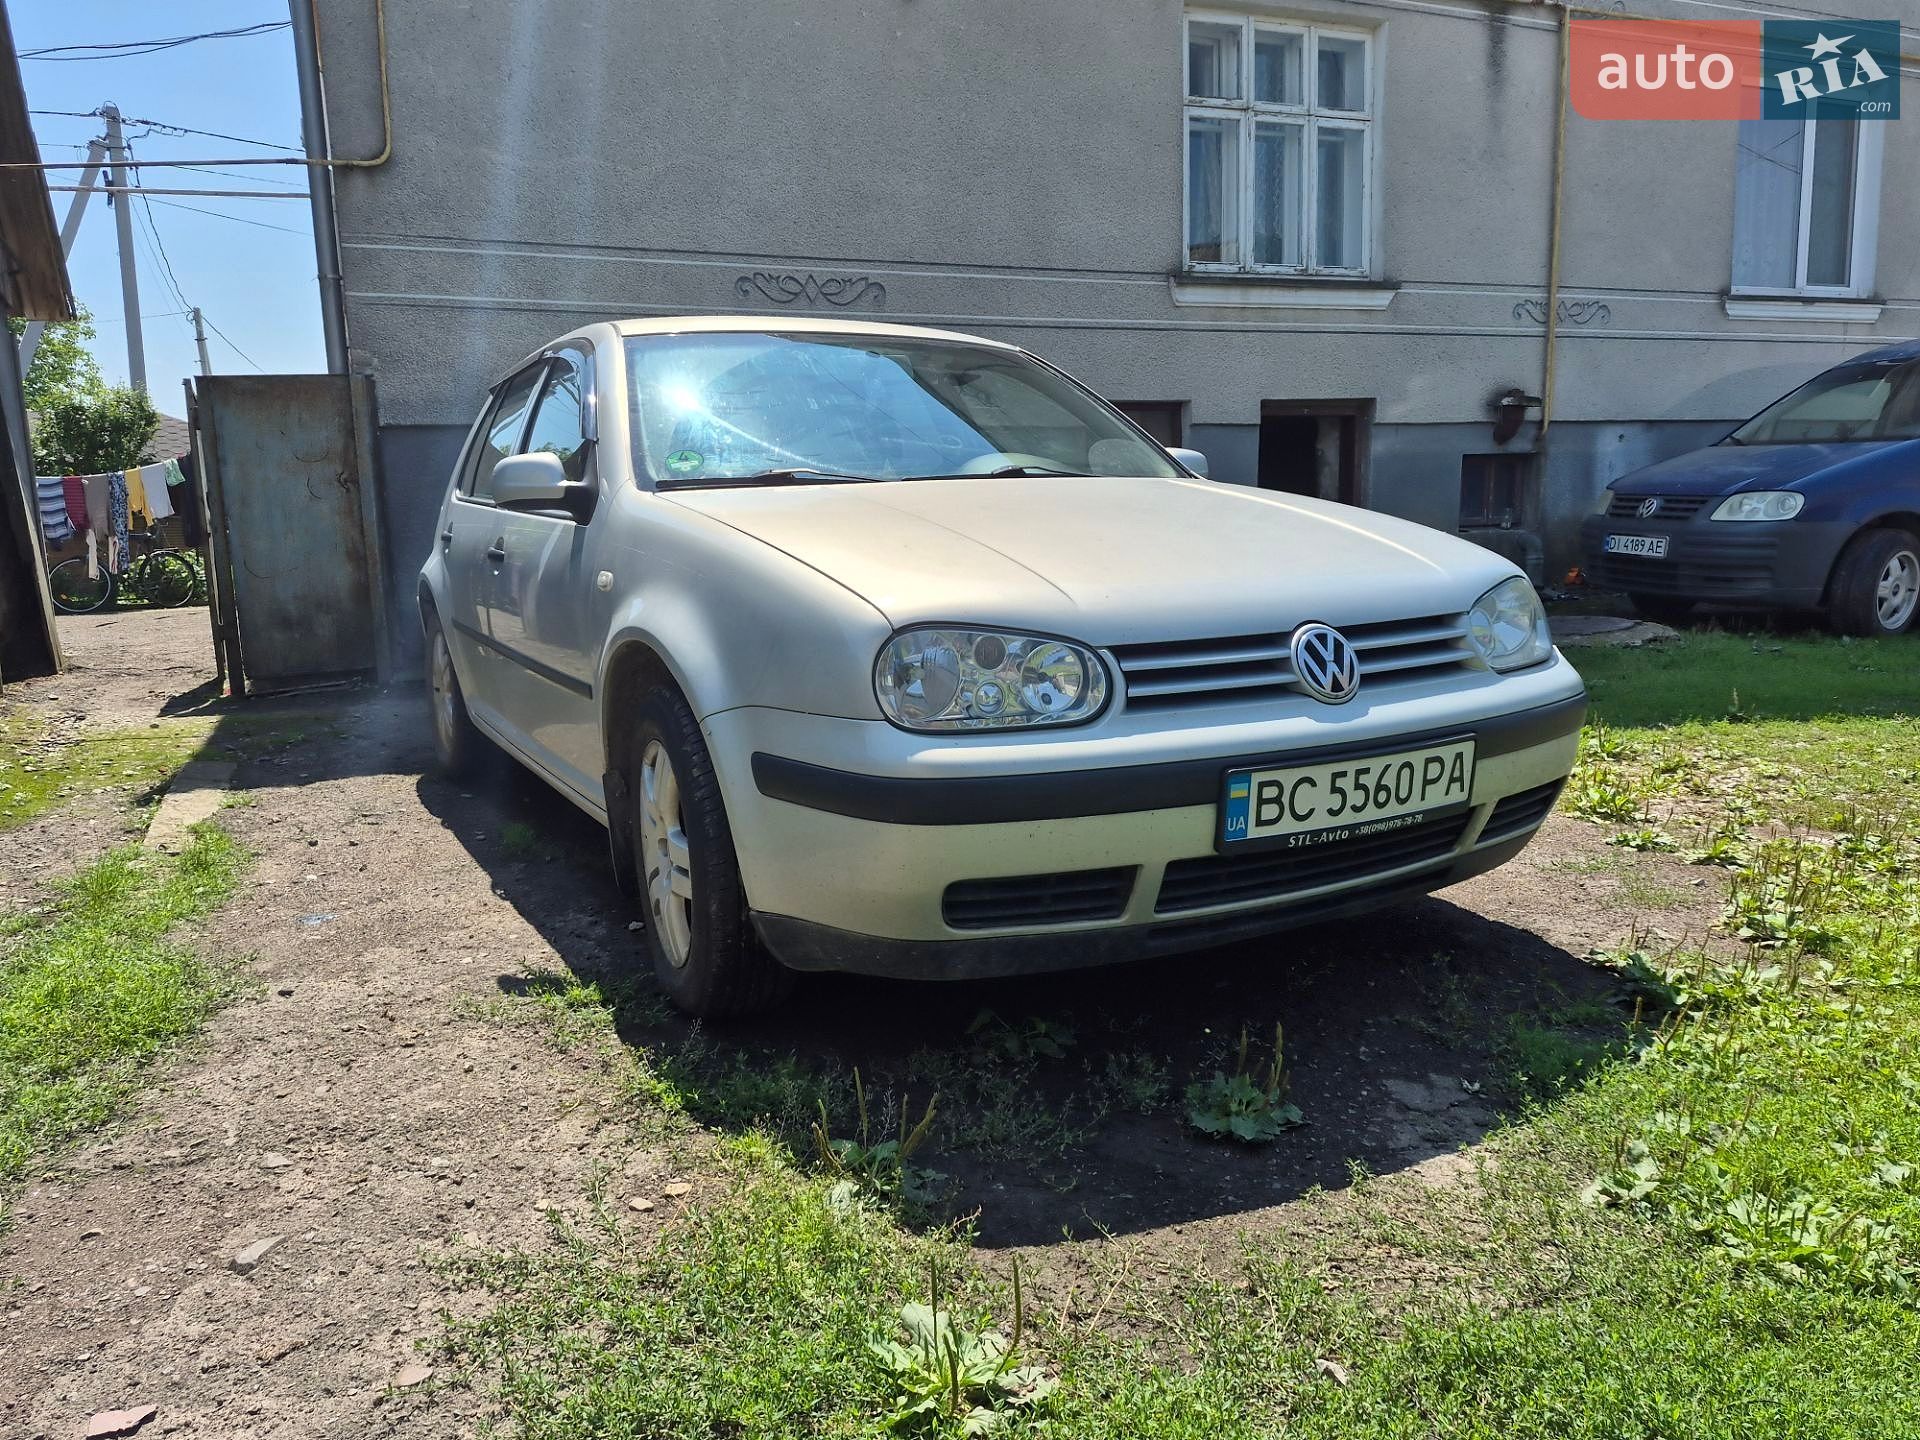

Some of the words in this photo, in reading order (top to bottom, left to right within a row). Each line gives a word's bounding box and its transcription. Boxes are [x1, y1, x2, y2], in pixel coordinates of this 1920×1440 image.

[1608, 537, 1620, 551] DI
[1623, 538, 1646, 552] 4189
[1647, 540, 1664, 554] AE
[1254, 775, 1318, 828] BC
[1326, 760, 1415, 817] 5560
[1420, 751, 1466, 802] PA
[1227, 817, 1246, 832] UA
[1287, 828, 1350, 849] STL-Avto
